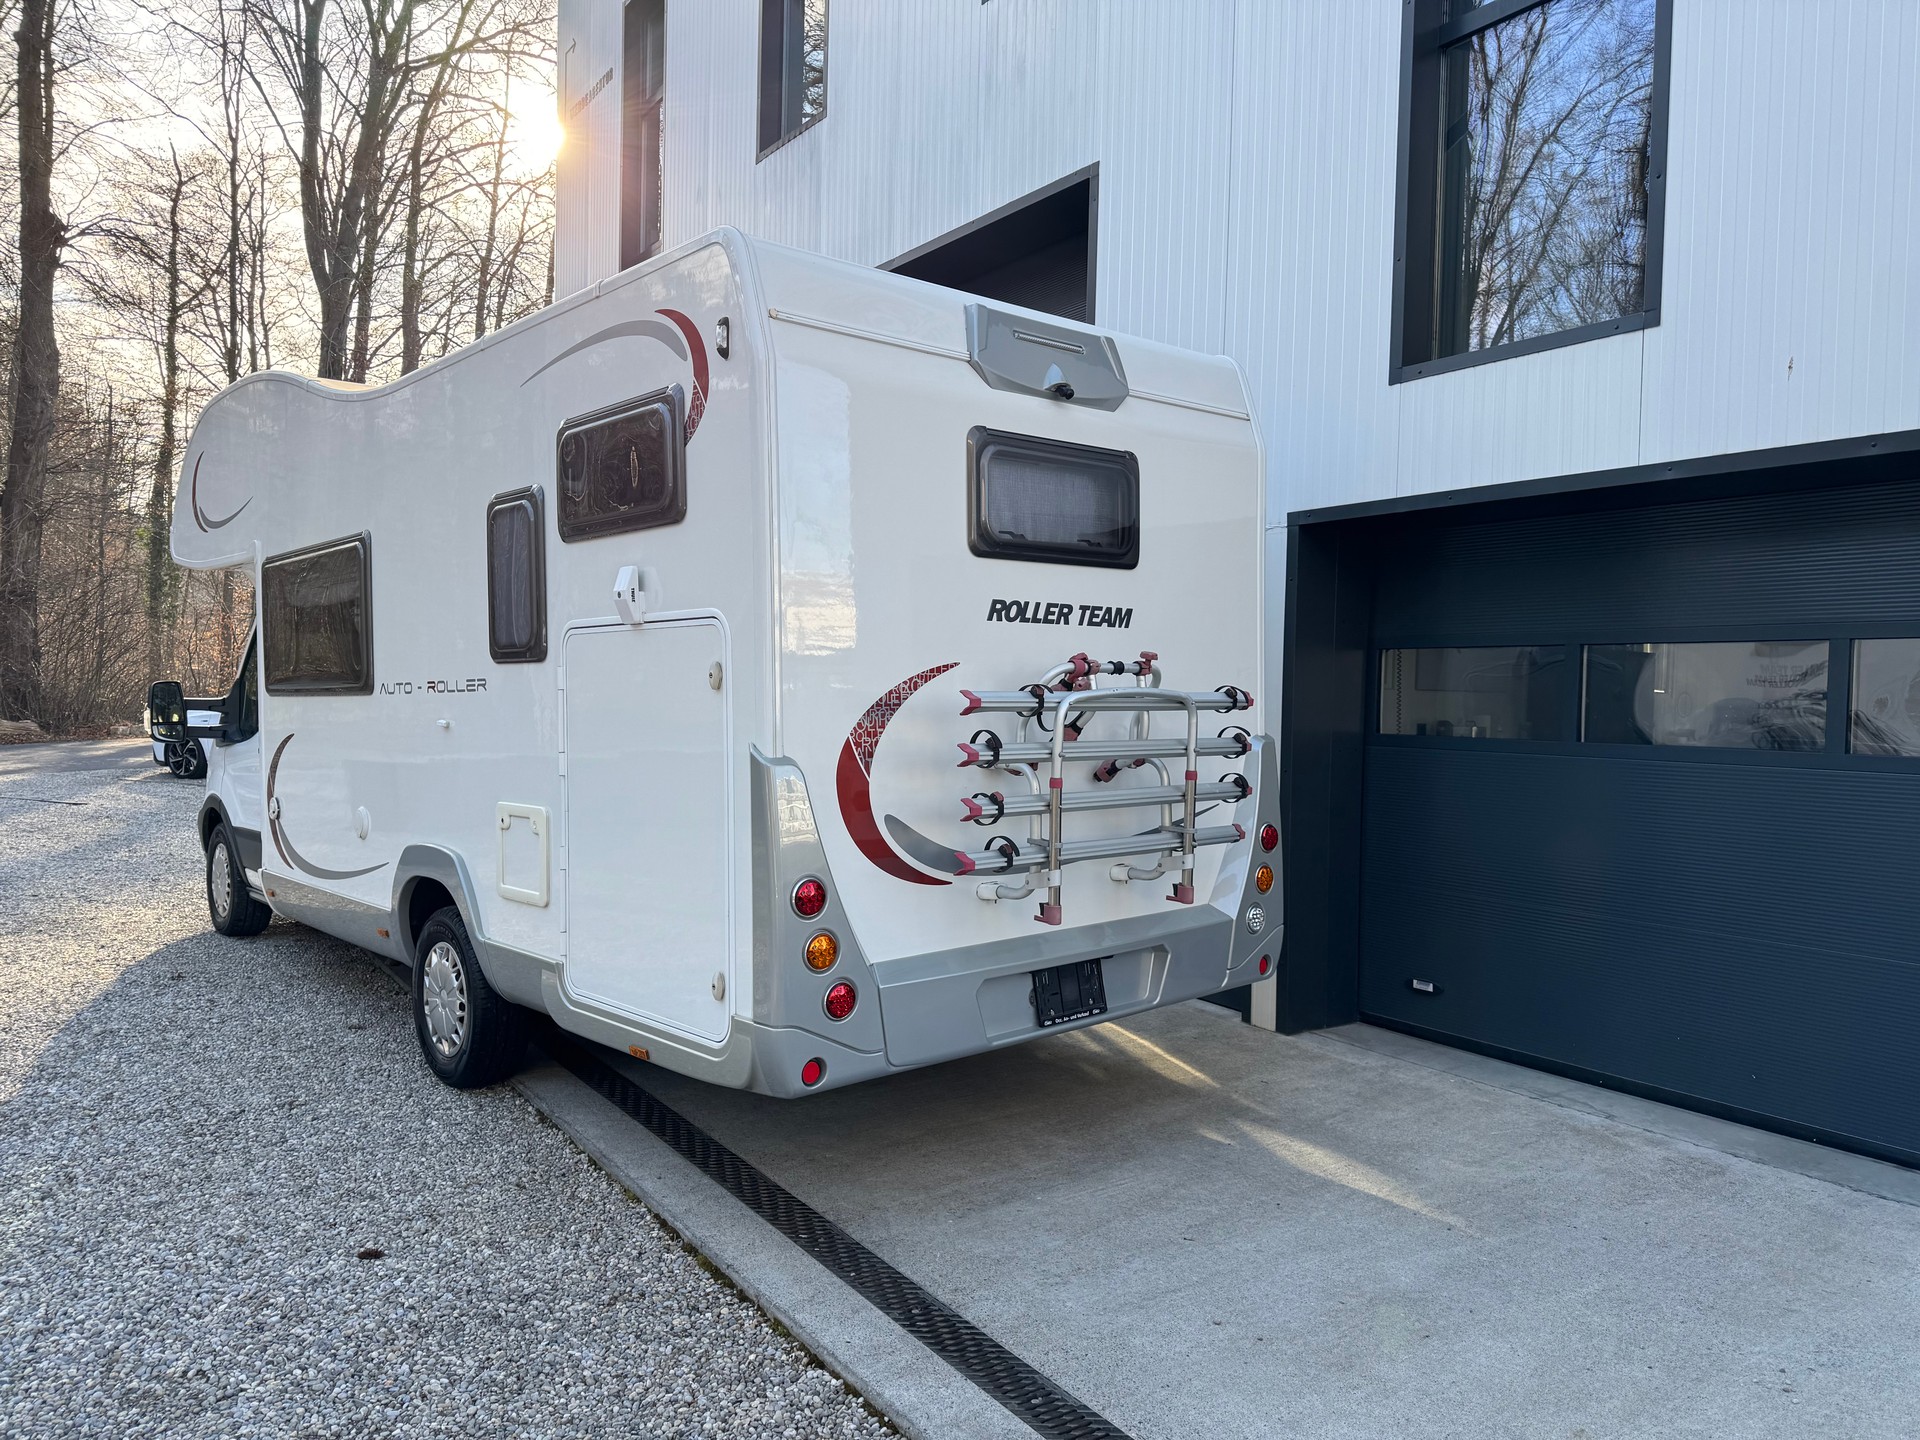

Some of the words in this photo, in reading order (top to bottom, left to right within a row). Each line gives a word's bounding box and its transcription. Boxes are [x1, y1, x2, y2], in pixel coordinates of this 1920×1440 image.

[986, 598, 1074, 626] ROLLER
[1077, 604, 1134, 629] TEAM
[379, 682, 413, 695] AUTO
[426, 678, 488, 694] ROLLER
